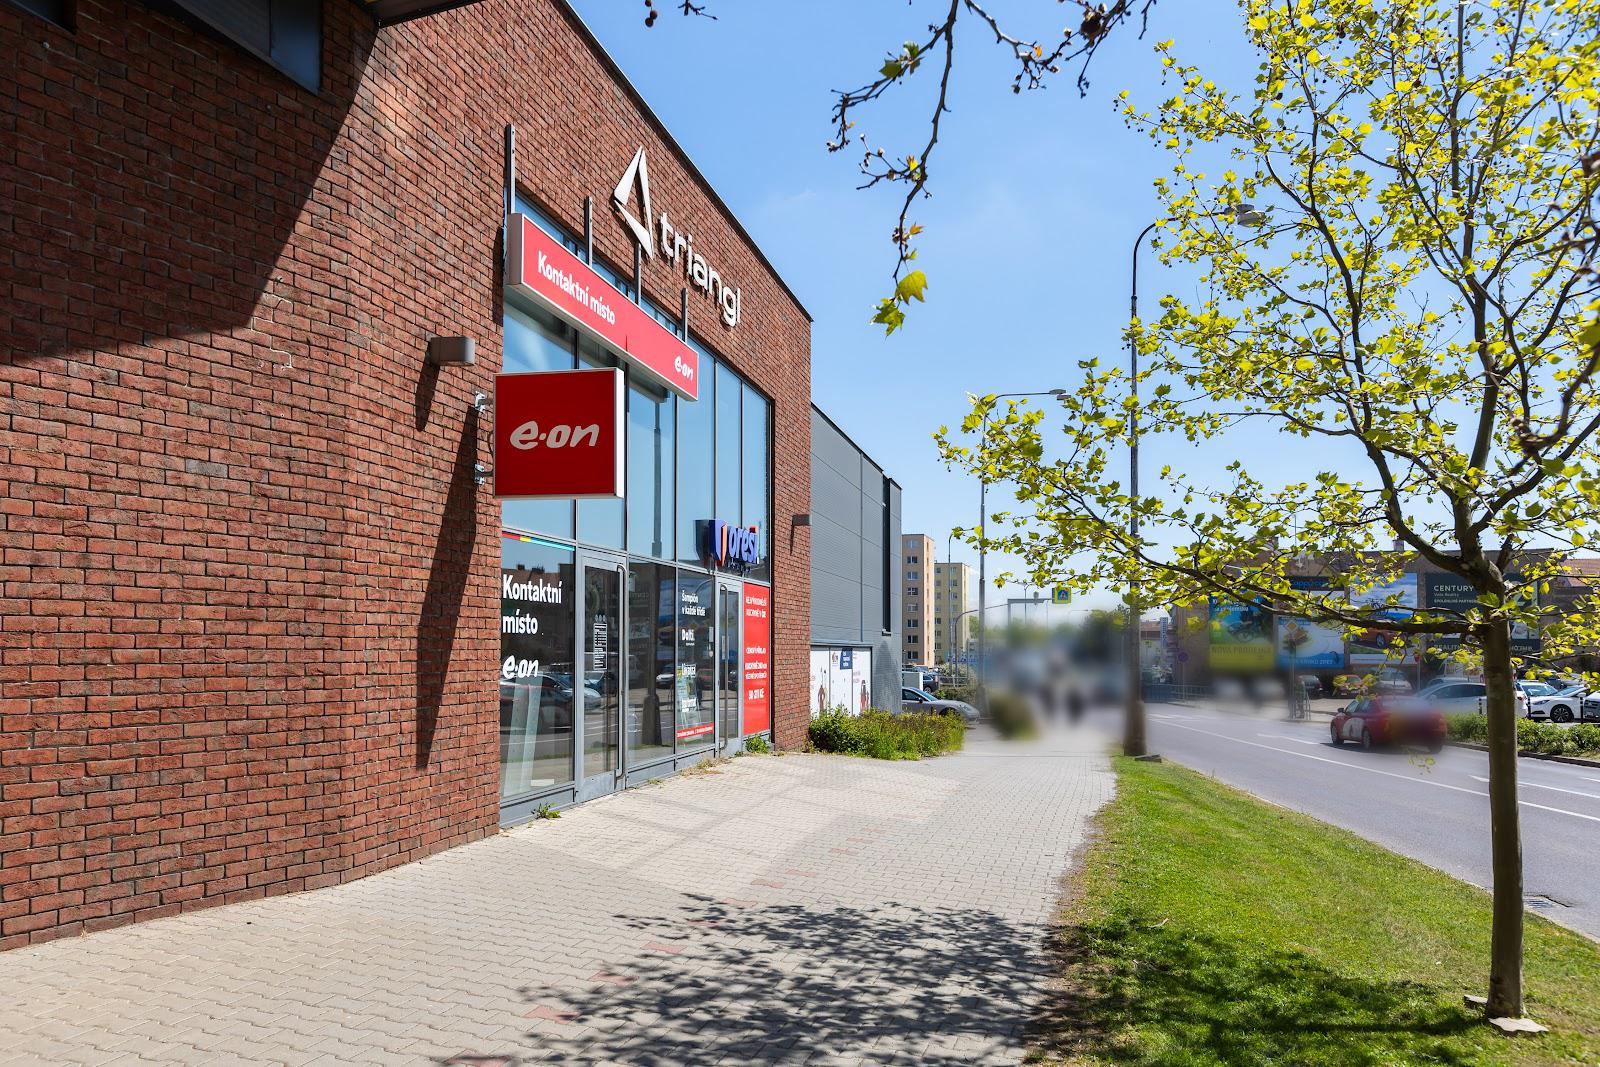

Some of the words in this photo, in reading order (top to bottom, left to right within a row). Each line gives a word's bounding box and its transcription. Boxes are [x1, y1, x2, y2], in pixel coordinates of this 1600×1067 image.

[537, 251, 589, 306] Kontaktní
[590, 297, 616, 325] místo
[660, 212, 741, 327] triangl
[502, 573, 562, 604] Kontaktní
[502, 608, 539, 635] místo
